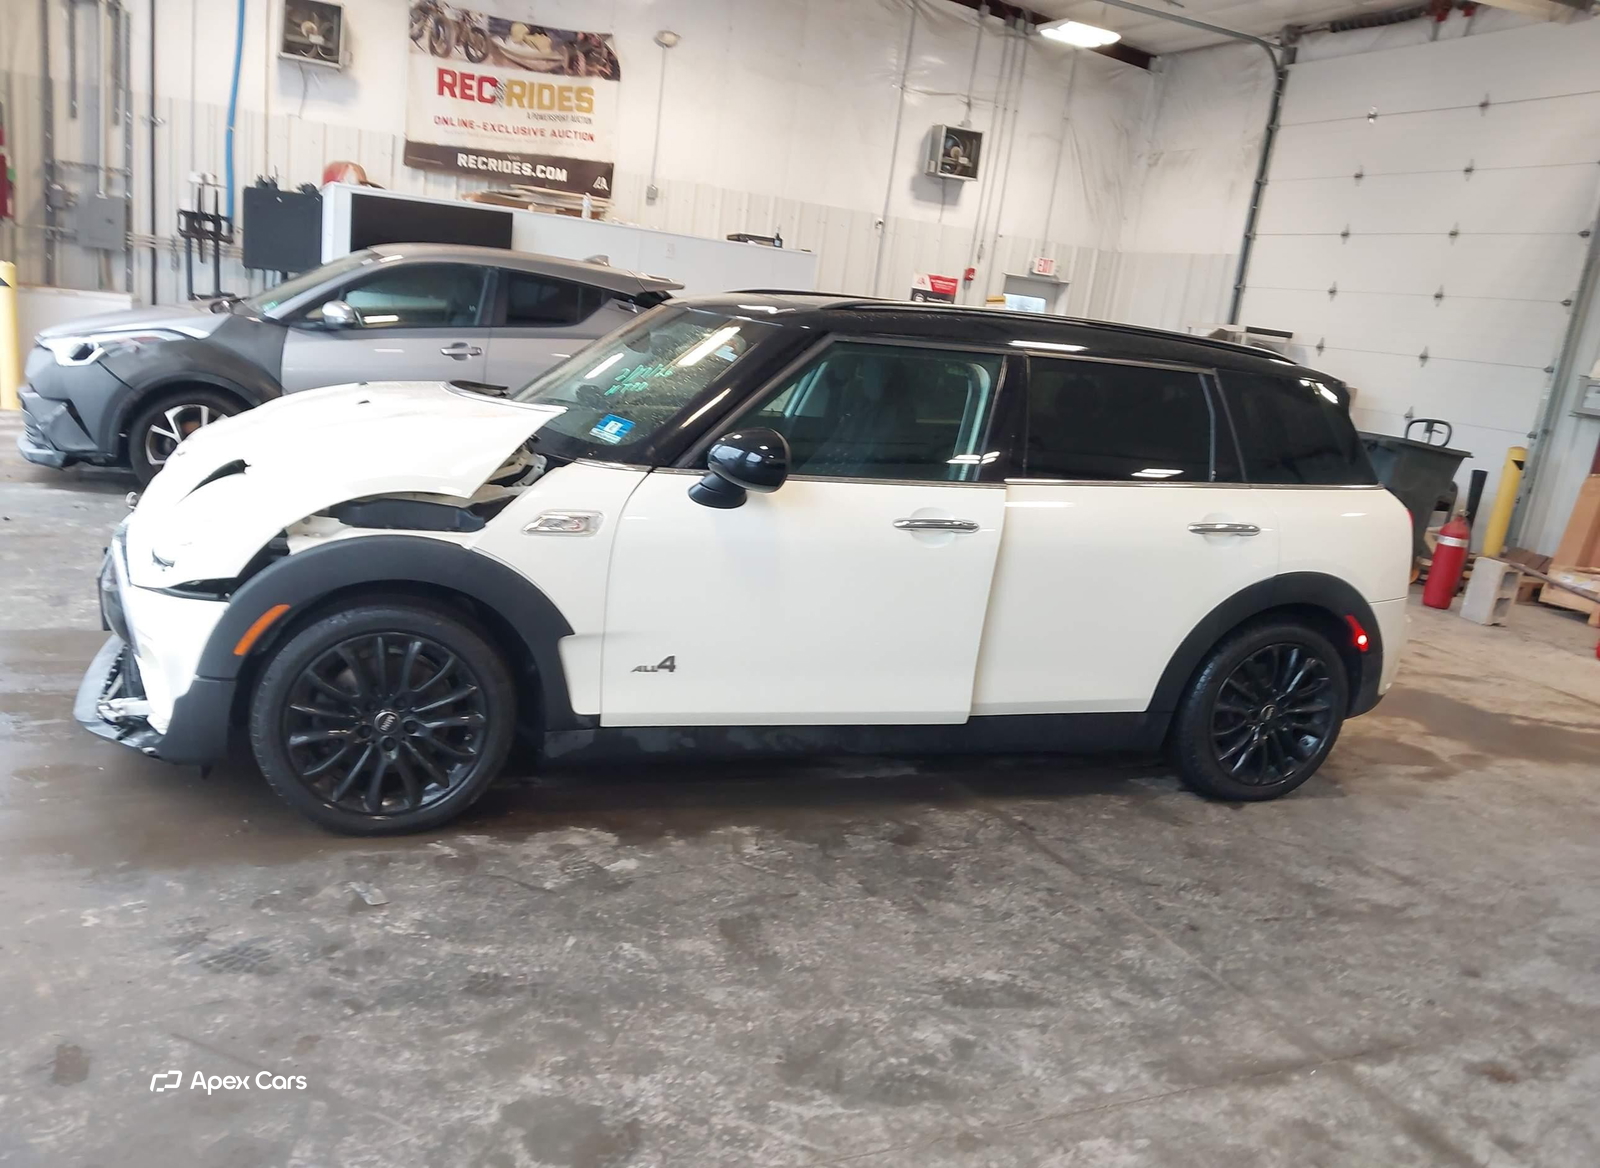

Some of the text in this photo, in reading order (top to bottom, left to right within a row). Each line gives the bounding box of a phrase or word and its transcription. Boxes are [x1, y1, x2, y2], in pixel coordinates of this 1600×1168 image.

[437, 67, 594, 114] REC RIDES
[434, 114, 546, 138] ONLINE-EXCLUSIVE
[550, 128, 595, 142] AUCTION
[457, 152, 568, 182] RECRIDES.COM
